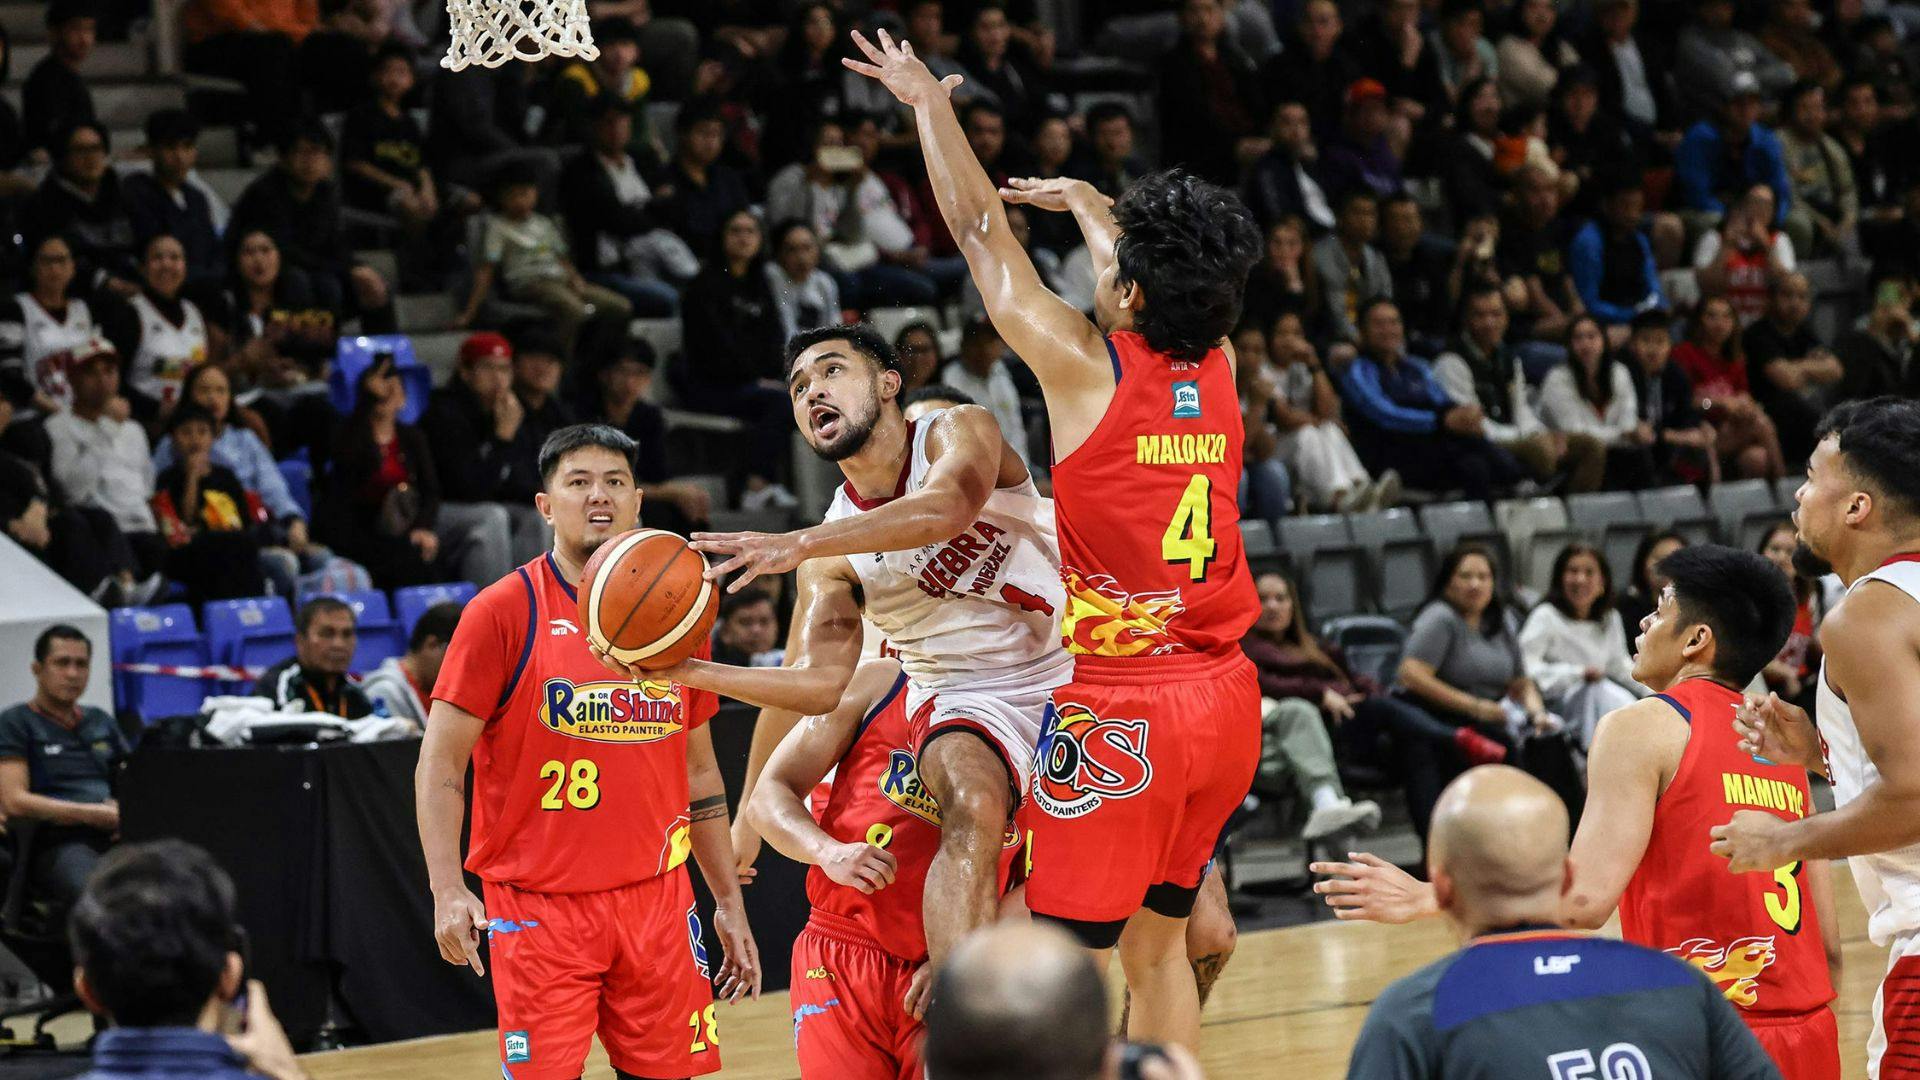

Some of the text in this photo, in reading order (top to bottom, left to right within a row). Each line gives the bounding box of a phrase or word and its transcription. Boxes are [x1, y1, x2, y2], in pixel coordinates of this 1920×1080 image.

[1136, 433, 1227, 465] MALONZO
[1162, 474, 1217, 583] 4
[967, 540, 1012, 596] MIGUEL
[578, 724, 620, 735] ELASTO
[539, 759, 600, 811] 28
[1052, 797, 1101, 817] PAINTERS
[507, 1040, 524, 1050] Sista
